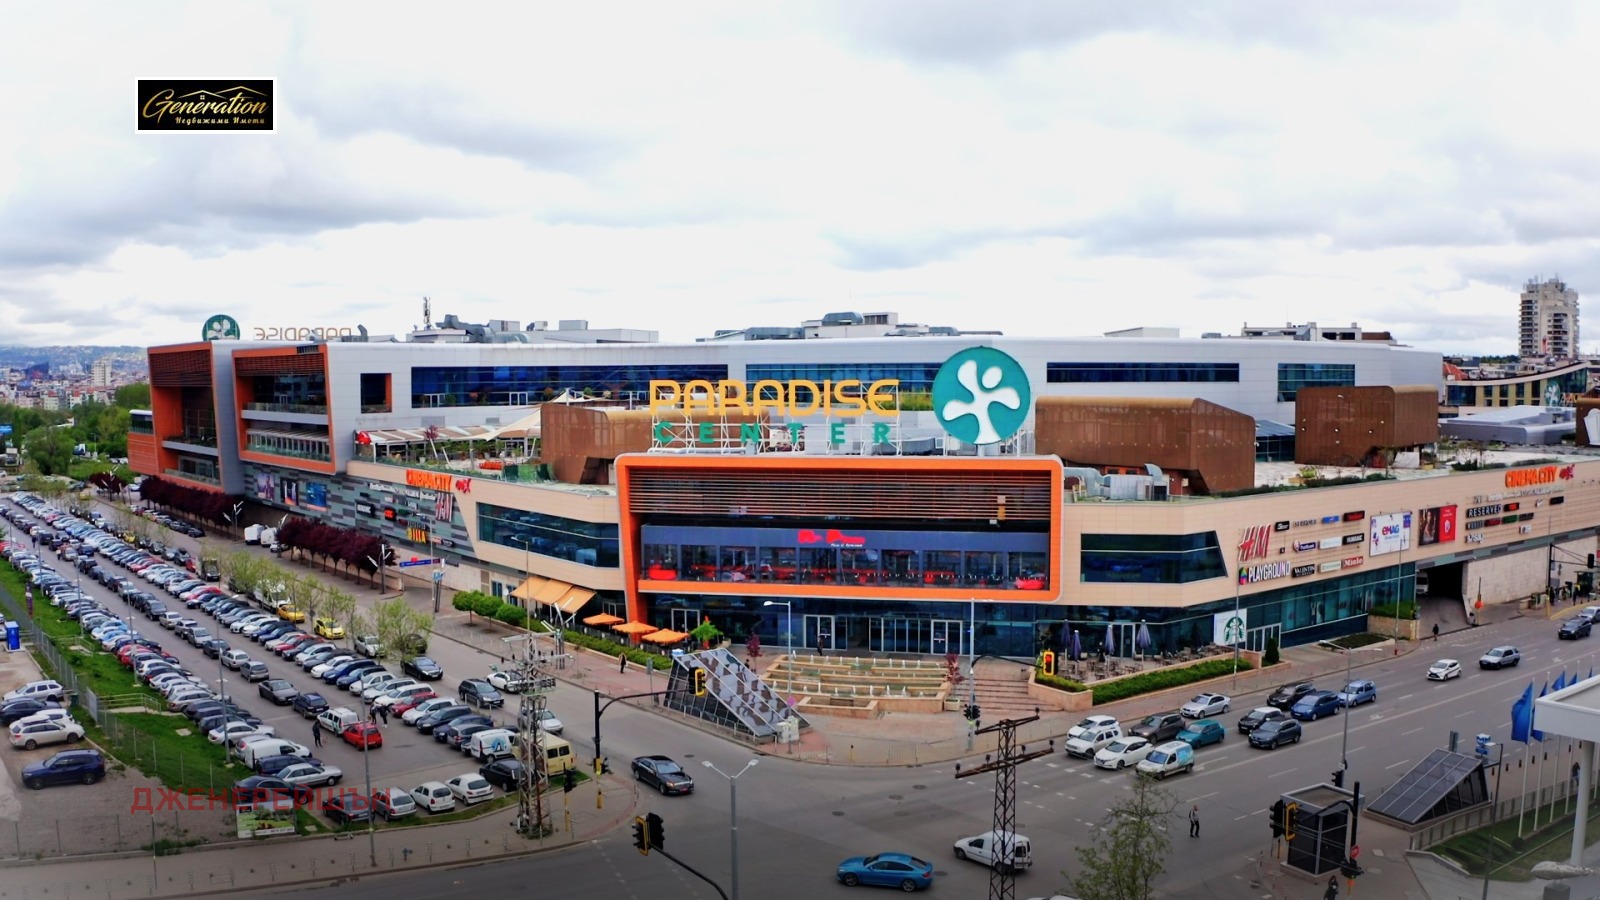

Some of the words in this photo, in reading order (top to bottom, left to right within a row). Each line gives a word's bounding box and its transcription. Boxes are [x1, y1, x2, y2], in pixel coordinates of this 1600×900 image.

[650, 380, 899, 417] PARADISE
[654, 421, 891, 444] CENTER
[1505, 470, 1537, 488] CINEMA
[1539, 466, 1557, 483] CITY
[1468, 504, 1501, 517] RESERVED
[1248, 561, 1290, 582] PLAYGROUND
[1344, 557, 1363, 567] Miele
